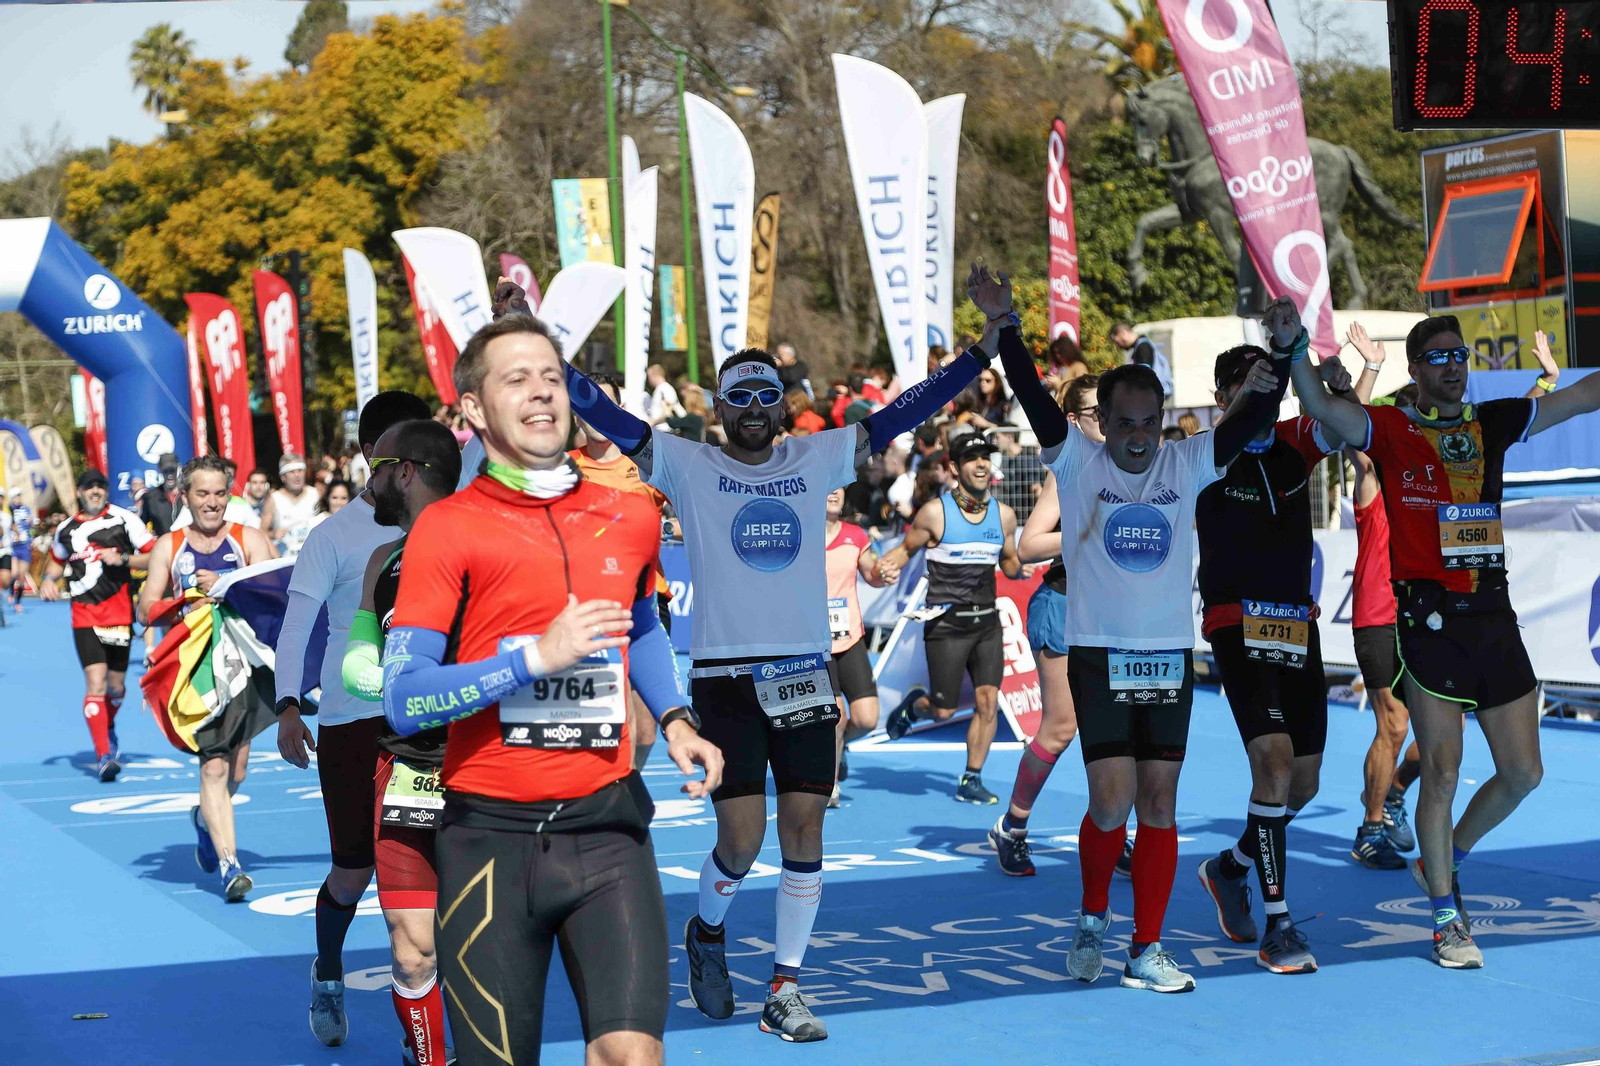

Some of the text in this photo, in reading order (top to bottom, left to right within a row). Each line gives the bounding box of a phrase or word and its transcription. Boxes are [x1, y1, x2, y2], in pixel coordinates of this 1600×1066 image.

[63, 312, 142, 335] ZURICH
[894, 369, 949, 410] Triatlón
[719, 475, 808, 497] RAFA MATEOS
[742, 523, 791, 536] JEREZ
[1114, 526, 1161, 540] JEREZ
[1456, 528, 1488, 543] 4560
[1263, 606, 1300, 618] ZURICH
[1259, 624, 1291, 640] 4731
[479, 666, 515, 691] ZURICH
[1124, 662, 1170, 677] 10317
[533, 677, 596, 701] 9764
[777, 679, 816, 701] 8795
[405, 684, 481, 718] SEVILLA ES
[549, 711, 582, 719] MARTIN
[591, 739, 619, 747] ZURICH
[409, 1007, 427, 1064] COMPRESPORT
